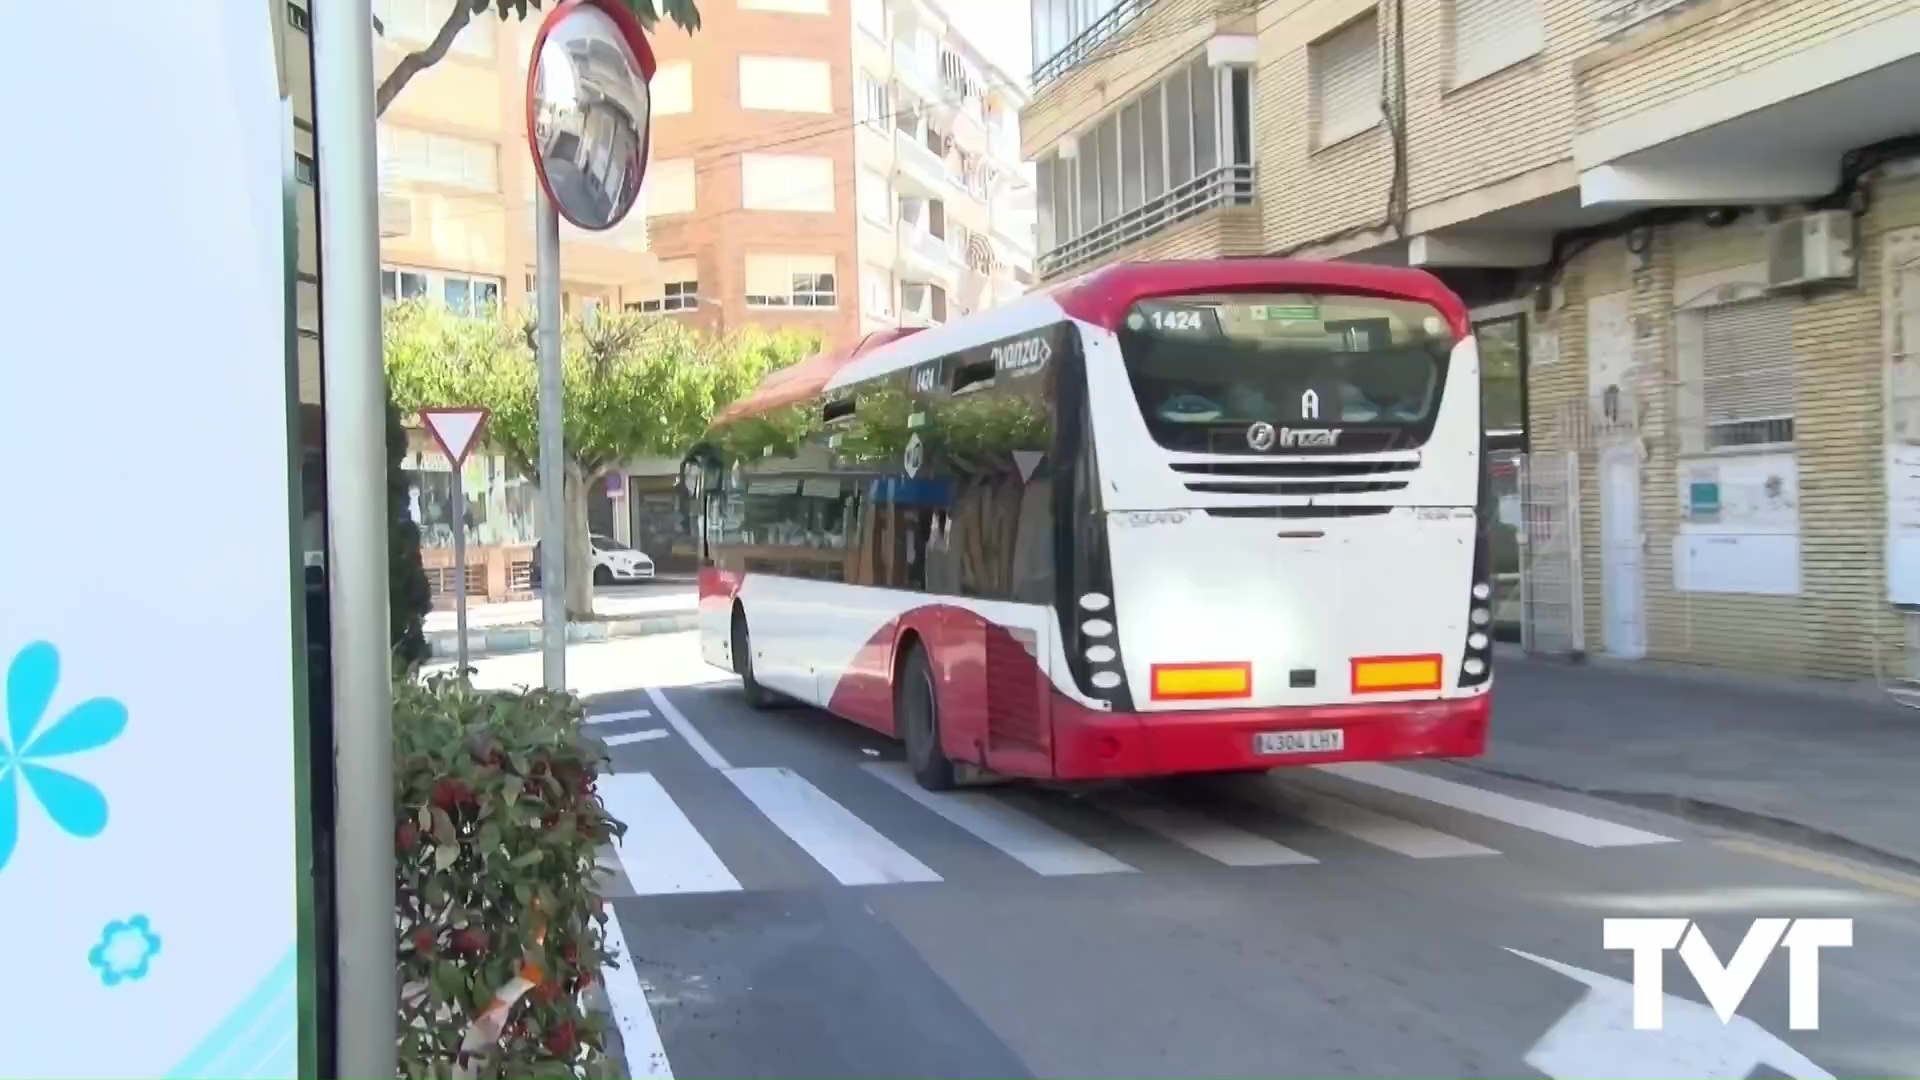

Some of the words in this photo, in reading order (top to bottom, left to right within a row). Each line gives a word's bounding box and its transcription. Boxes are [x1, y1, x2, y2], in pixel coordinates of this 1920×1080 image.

[1150, 309, 1201, 331] 1424
[1301, 389, 1320, 420] A
[1264, 734, 1305, 750] 4304
